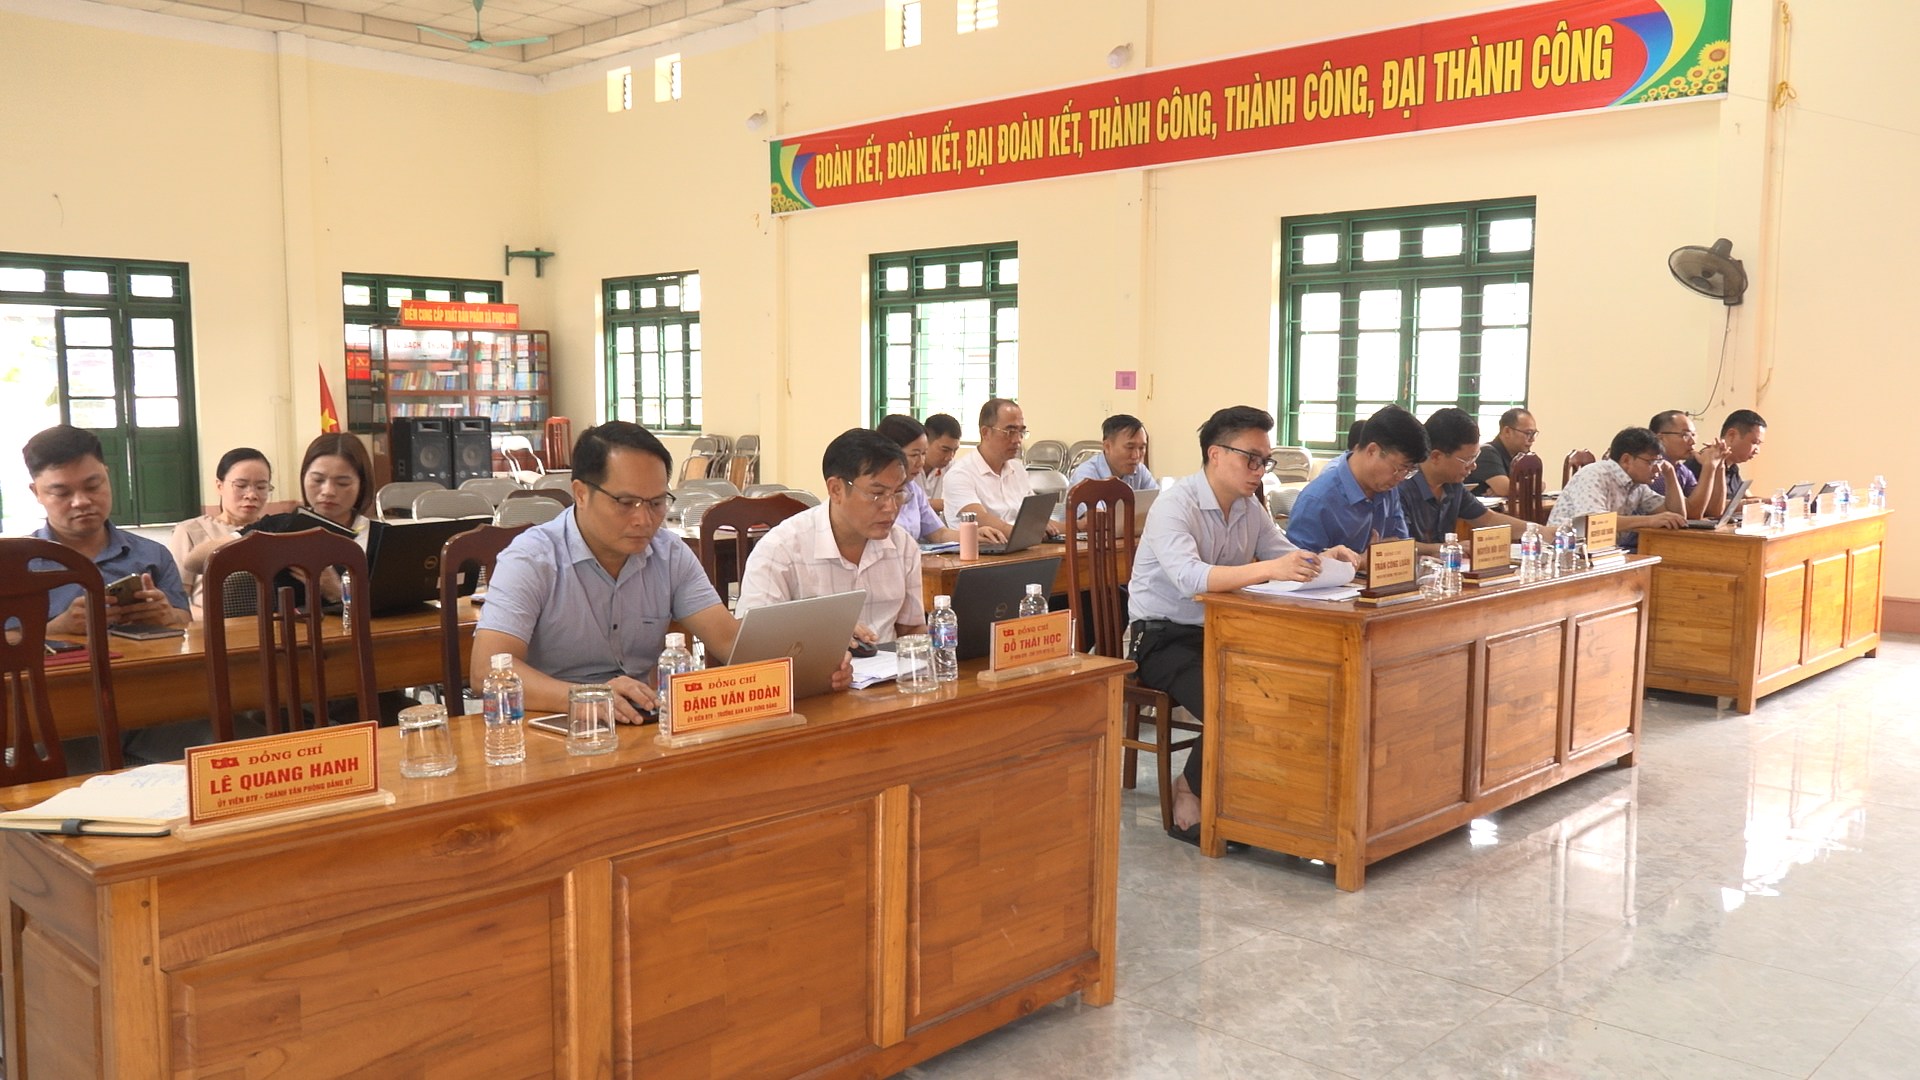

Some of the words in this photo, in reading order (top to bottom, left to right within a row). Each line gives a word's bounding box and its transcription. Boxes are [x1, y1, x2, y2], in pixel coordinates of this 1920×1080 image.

[815, 144, 852, 190] ĐOÀN
[855, 133, 884, 186] KẾT,
[886, 131, 928, 180] ĐOÀN
[931, 120, 961, 175] KẾT,
[965, 126, 993, 176] ĐẠI
[997, 111, 1044, 164] ĐOÀN
[1048, 99, 1084, 156] KẾT,
[1088, 96, 1151, 151] THÀNH
[1156, 86, 1218, 142] CÔNG,
[1224, 72, 1297, 132] THÀNH
[1303, 60, 1375, 122] CÔNG,
[1382, 55, 1426, 119] ĐẠI
[1433, 35, 1524, 103] THÀNH
[1531, 20, 1614, 89] CÔNG
[1020, 636, 1040, 649] THÁI
[1044, 633, 1062, 646] HỌC
[708, 678, 736, 689] ĐỒNG
[739, 674, 756, 684] CHÍ
[684, 696, 717, 714] ĐẶNG
[721, 690, 745, 706] VĂN
[749, 685, 780, 701] ĐOÀN
[248, 750, 292, 765] ĐỒNG
[297, 743, 323, 757] CHÍ
[210, 775, 232, 794] LÊ
[240, 766, 303, 790] QUANG
[310, 757, 359, 778] HANH
[228, 796, 244, 806] VIÊN
[246, 794, 258, 802] BTV
[303, 783, 325, 793] PHÒNG
